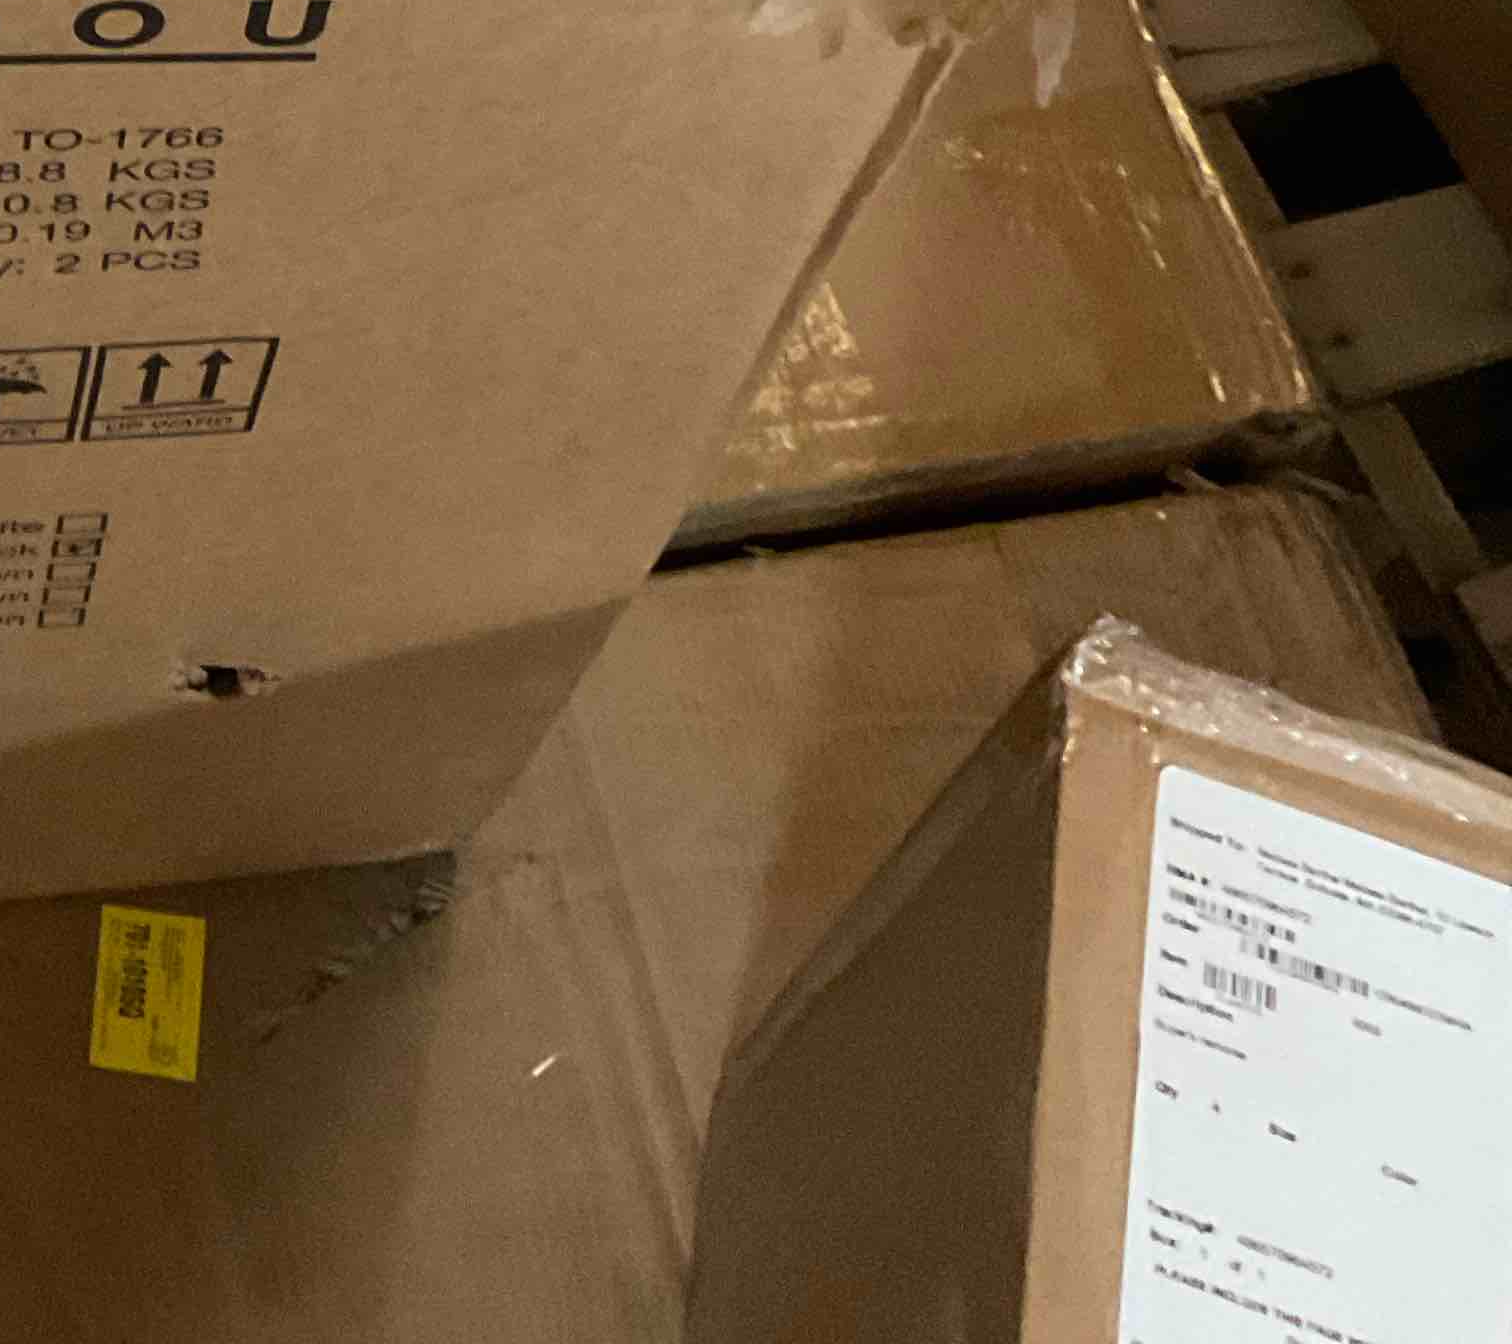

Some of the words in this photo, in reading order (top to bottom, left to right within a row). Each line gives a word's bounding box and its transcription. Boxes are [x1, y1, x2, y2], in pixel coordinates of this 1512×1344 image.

[12, 126, 226, 153] TO-1766
[108, 157, 218, 184] KGS
[105, 187, 211, 214] KGS
[133, 217, 205, 242] M3
[54, 253, 82, 275] 2
[101, 248, 203, 273] PCS
